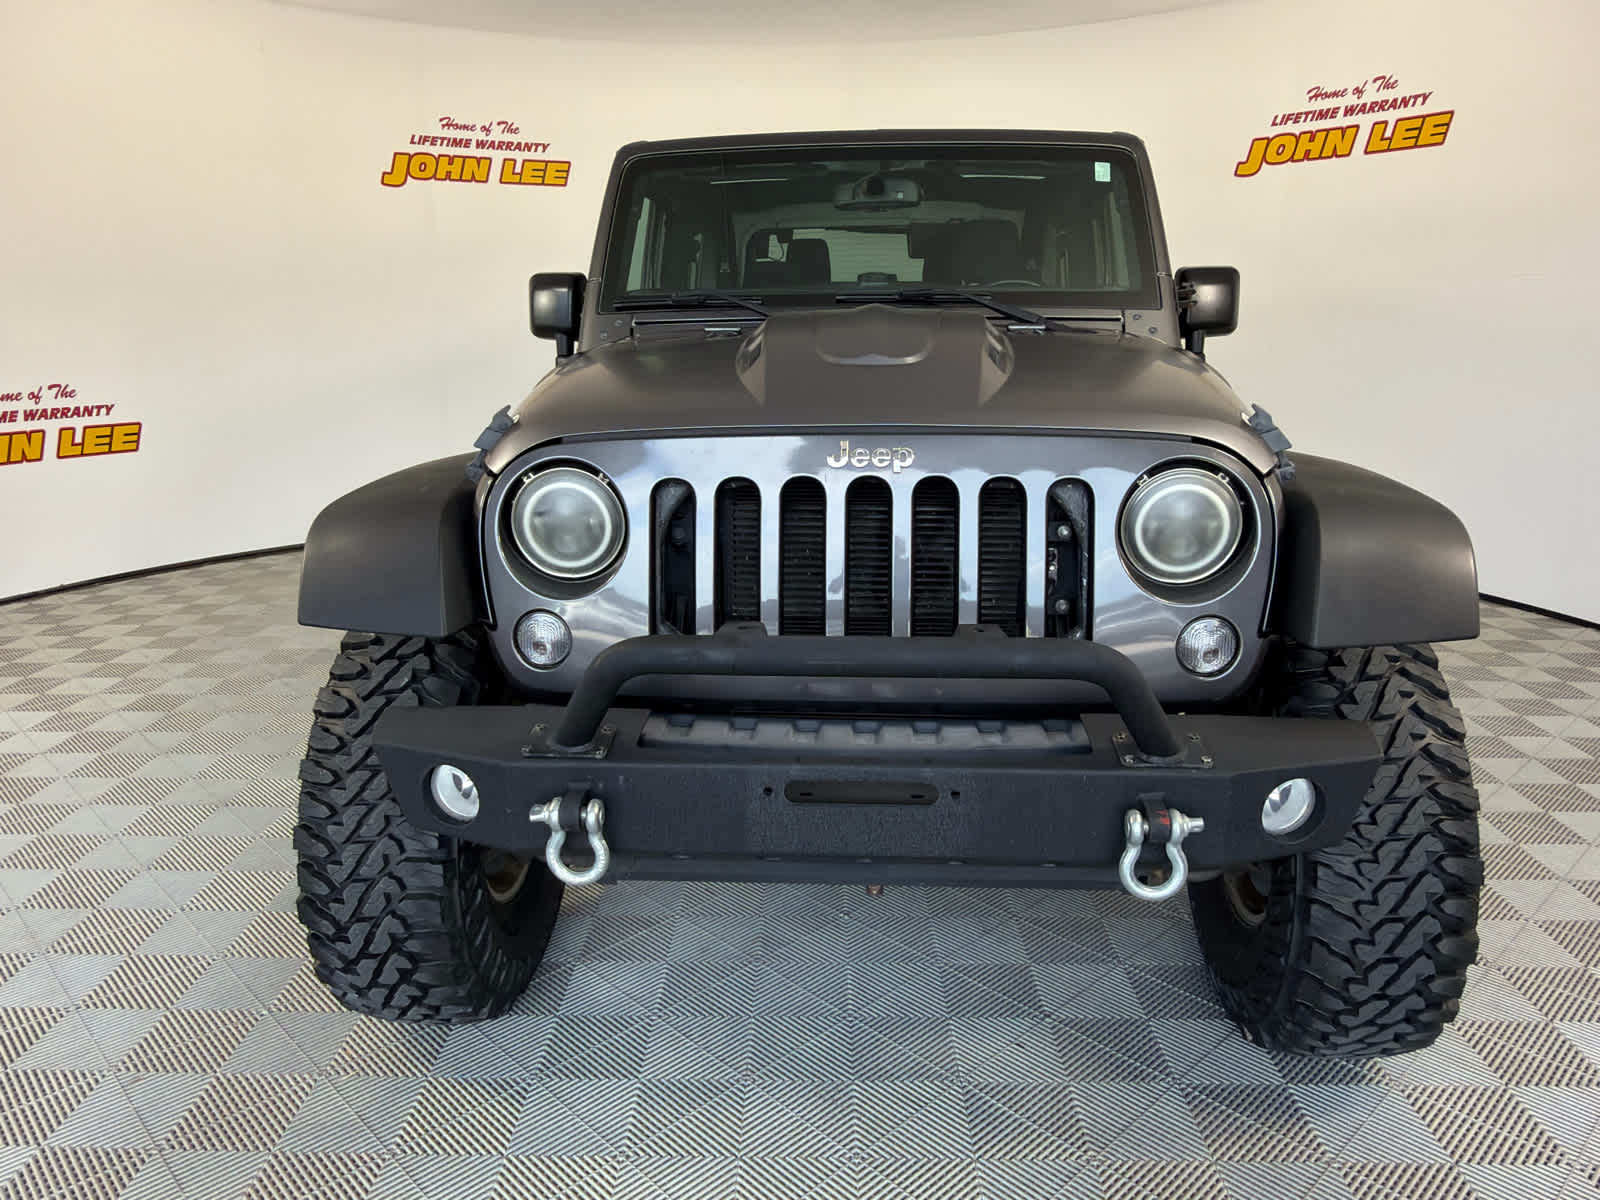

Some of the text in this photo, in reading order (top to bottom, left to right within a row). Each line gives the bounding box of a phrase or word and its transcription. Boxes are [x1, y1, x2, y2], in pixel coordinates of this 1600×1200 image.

[1306, 74, 1399, 103] Home of The
[1271, 91, 1434, 127] LIFETIME WARRANTY
[438, 116, 520, 136] Home of The
[409, 134, 551, 153] LIFETIME WARRANTY
[1234, 110, 1455, 177] JOHN LEE
[381, 152, 571, 187] JOHN LEE
[27, 385, 43, 405] of
[47, 383, 77, 400] The
[23, 404, 115, 421] WARRANTY
[56, 421, 142, 459] LEE
[826, 440, 914, 473] Jeep
